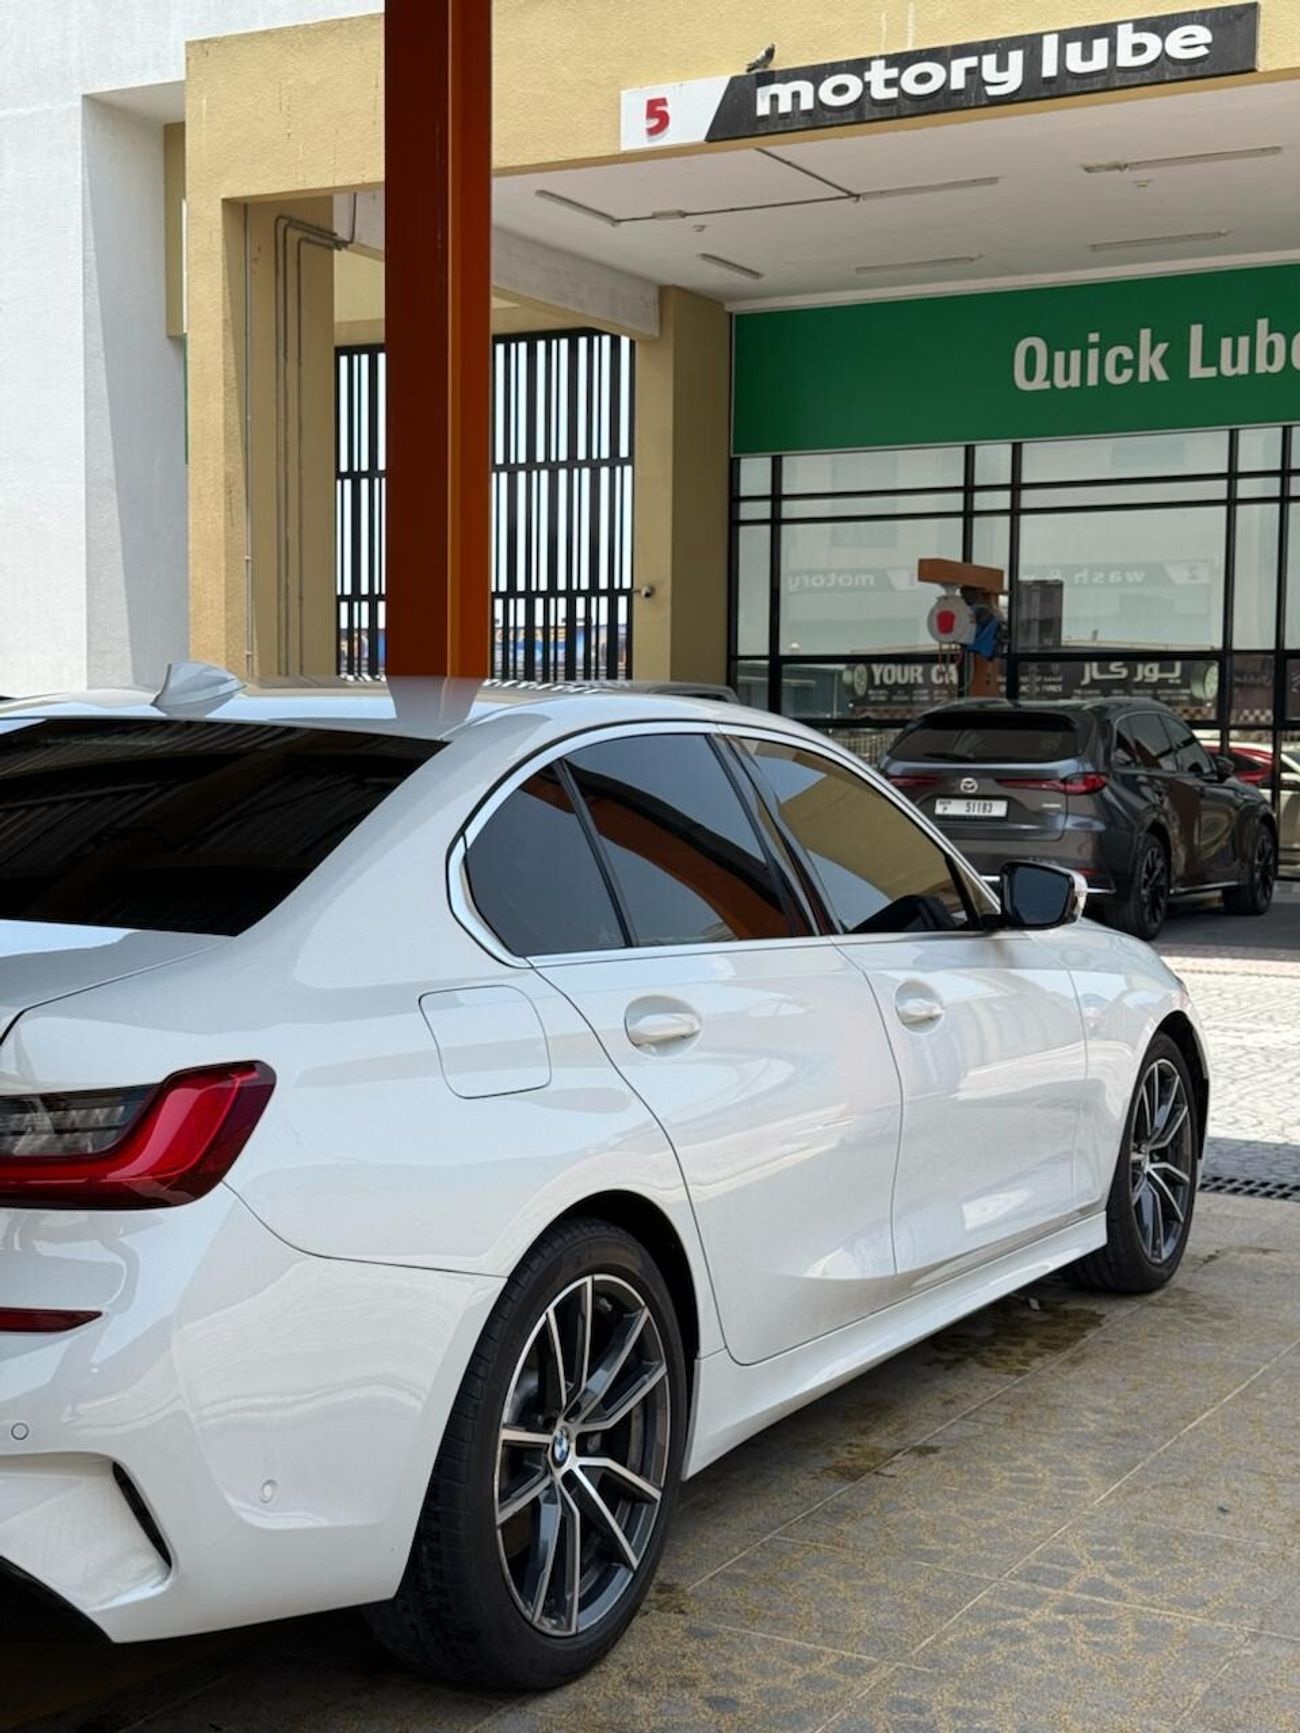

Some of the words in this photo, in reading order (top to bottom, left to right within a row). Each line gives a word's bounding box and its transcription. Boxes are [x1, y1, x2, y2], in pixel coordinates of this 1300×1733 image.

[645, 97, 671, 136] 5
[756, 44, 1025, 117] motory
[1042, 22, 1213, 79] lube
[1014, 327, 1169, 392] Quick
[871, 663, 924, 685] YOUR
